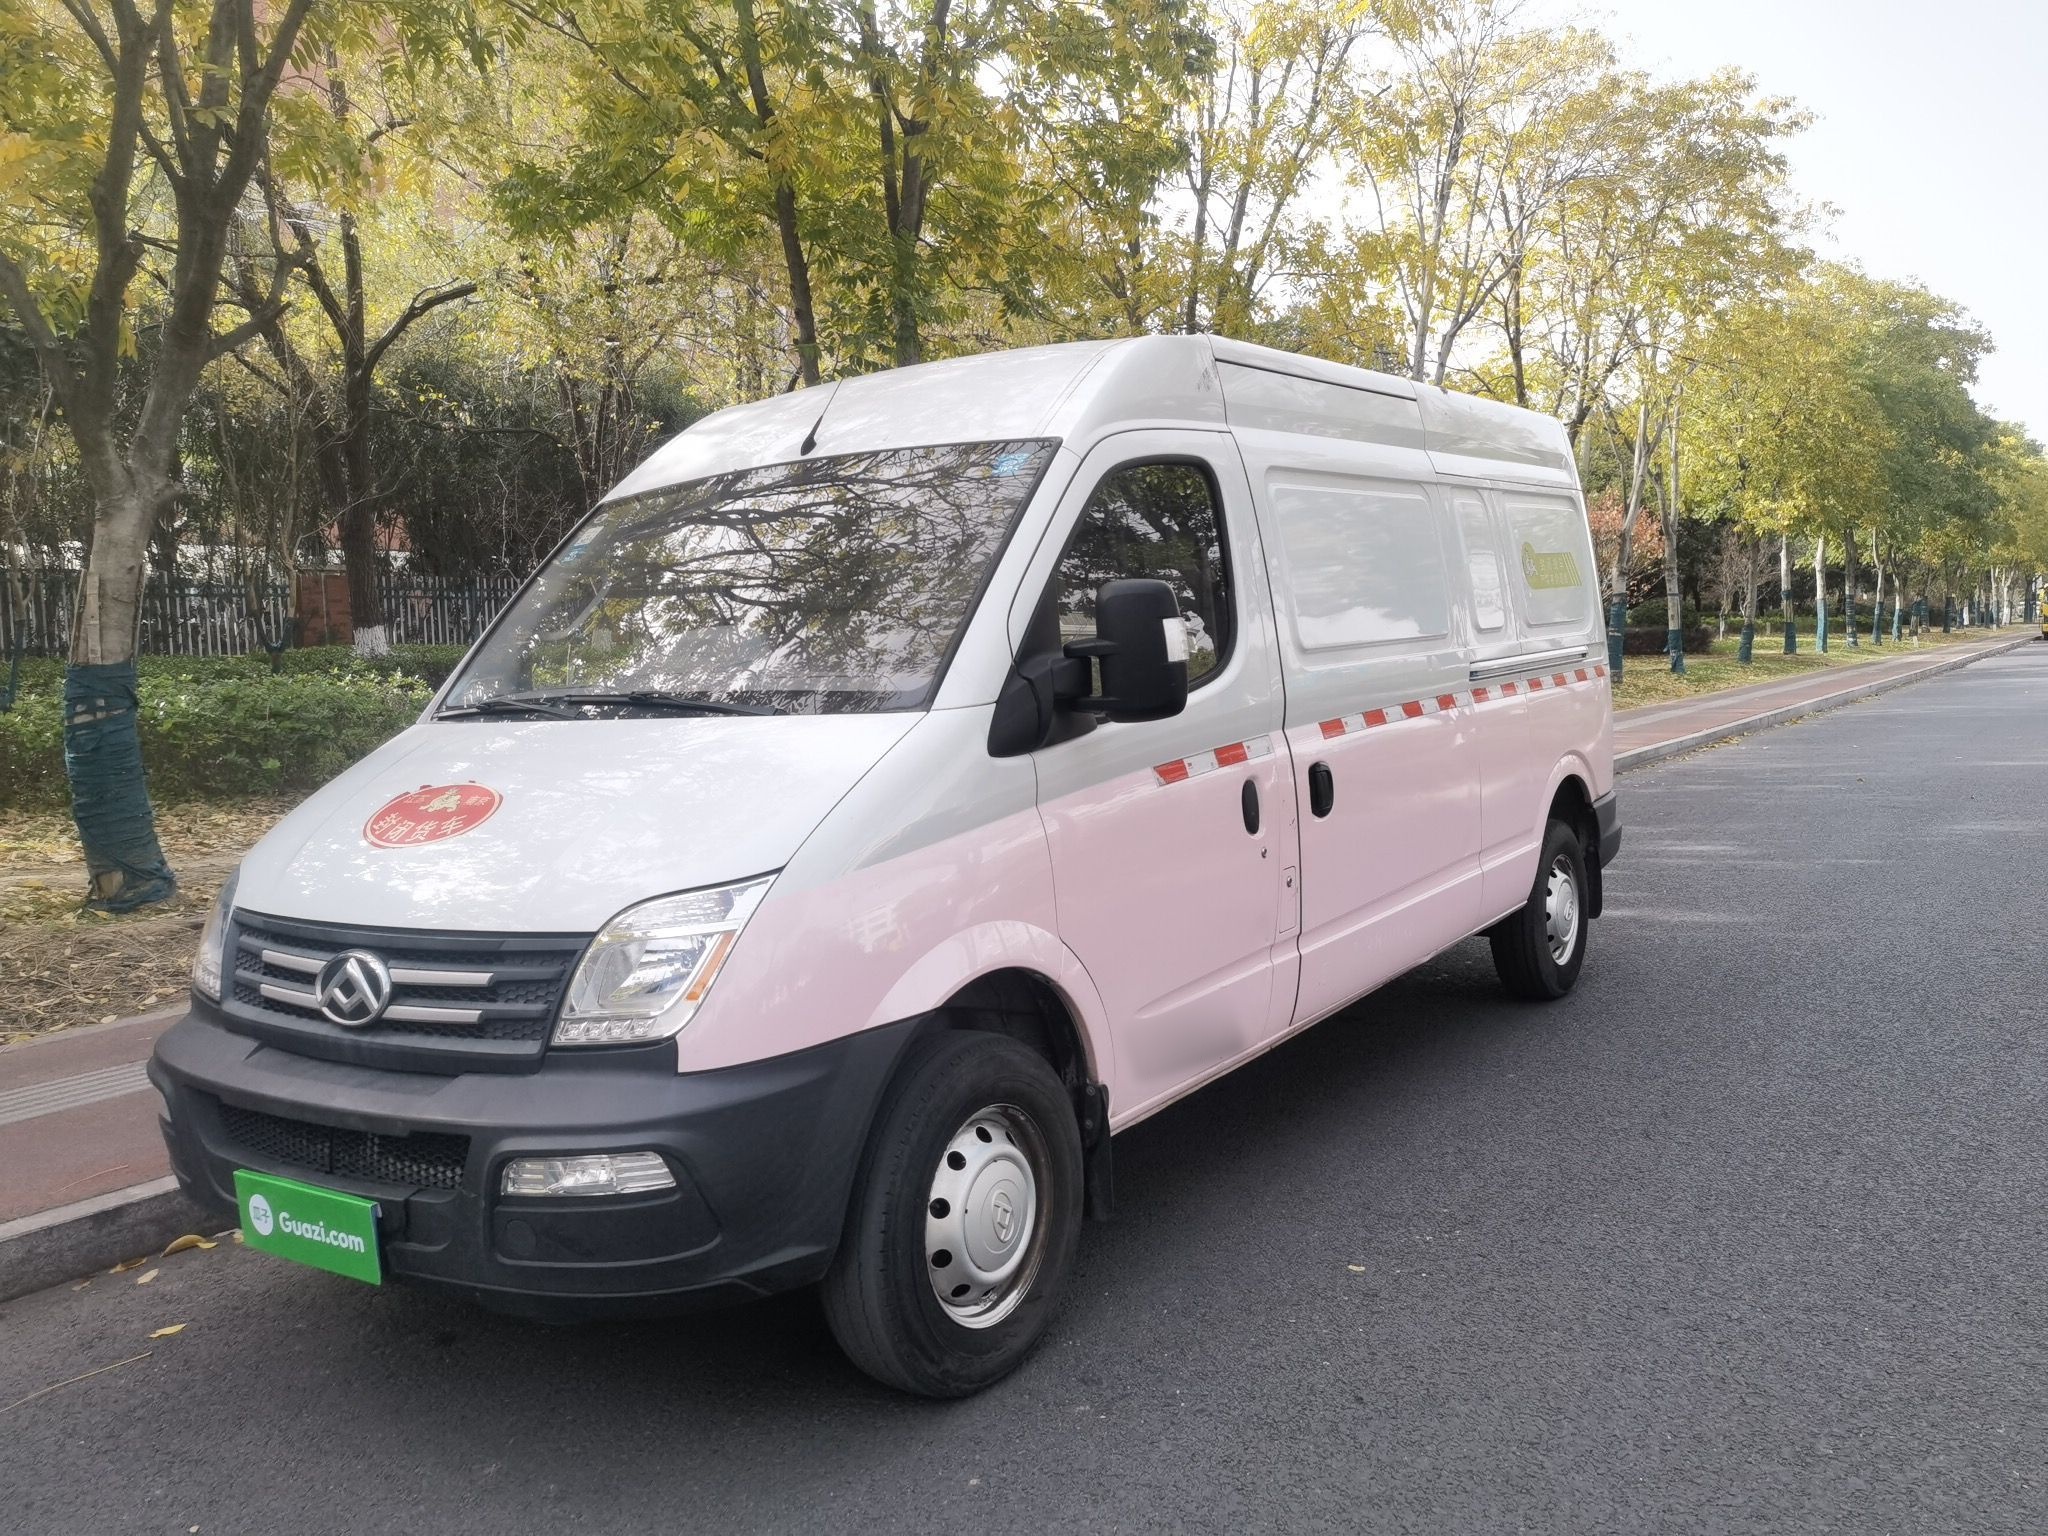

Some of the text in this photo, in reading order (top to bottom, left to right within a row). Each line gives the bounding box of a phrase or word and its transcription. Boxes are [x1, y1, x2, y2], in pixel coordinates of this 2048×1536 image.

[373, 812, 467, 842] 封闭货车
[278, 1211, 365, 1253] Guazi.com
